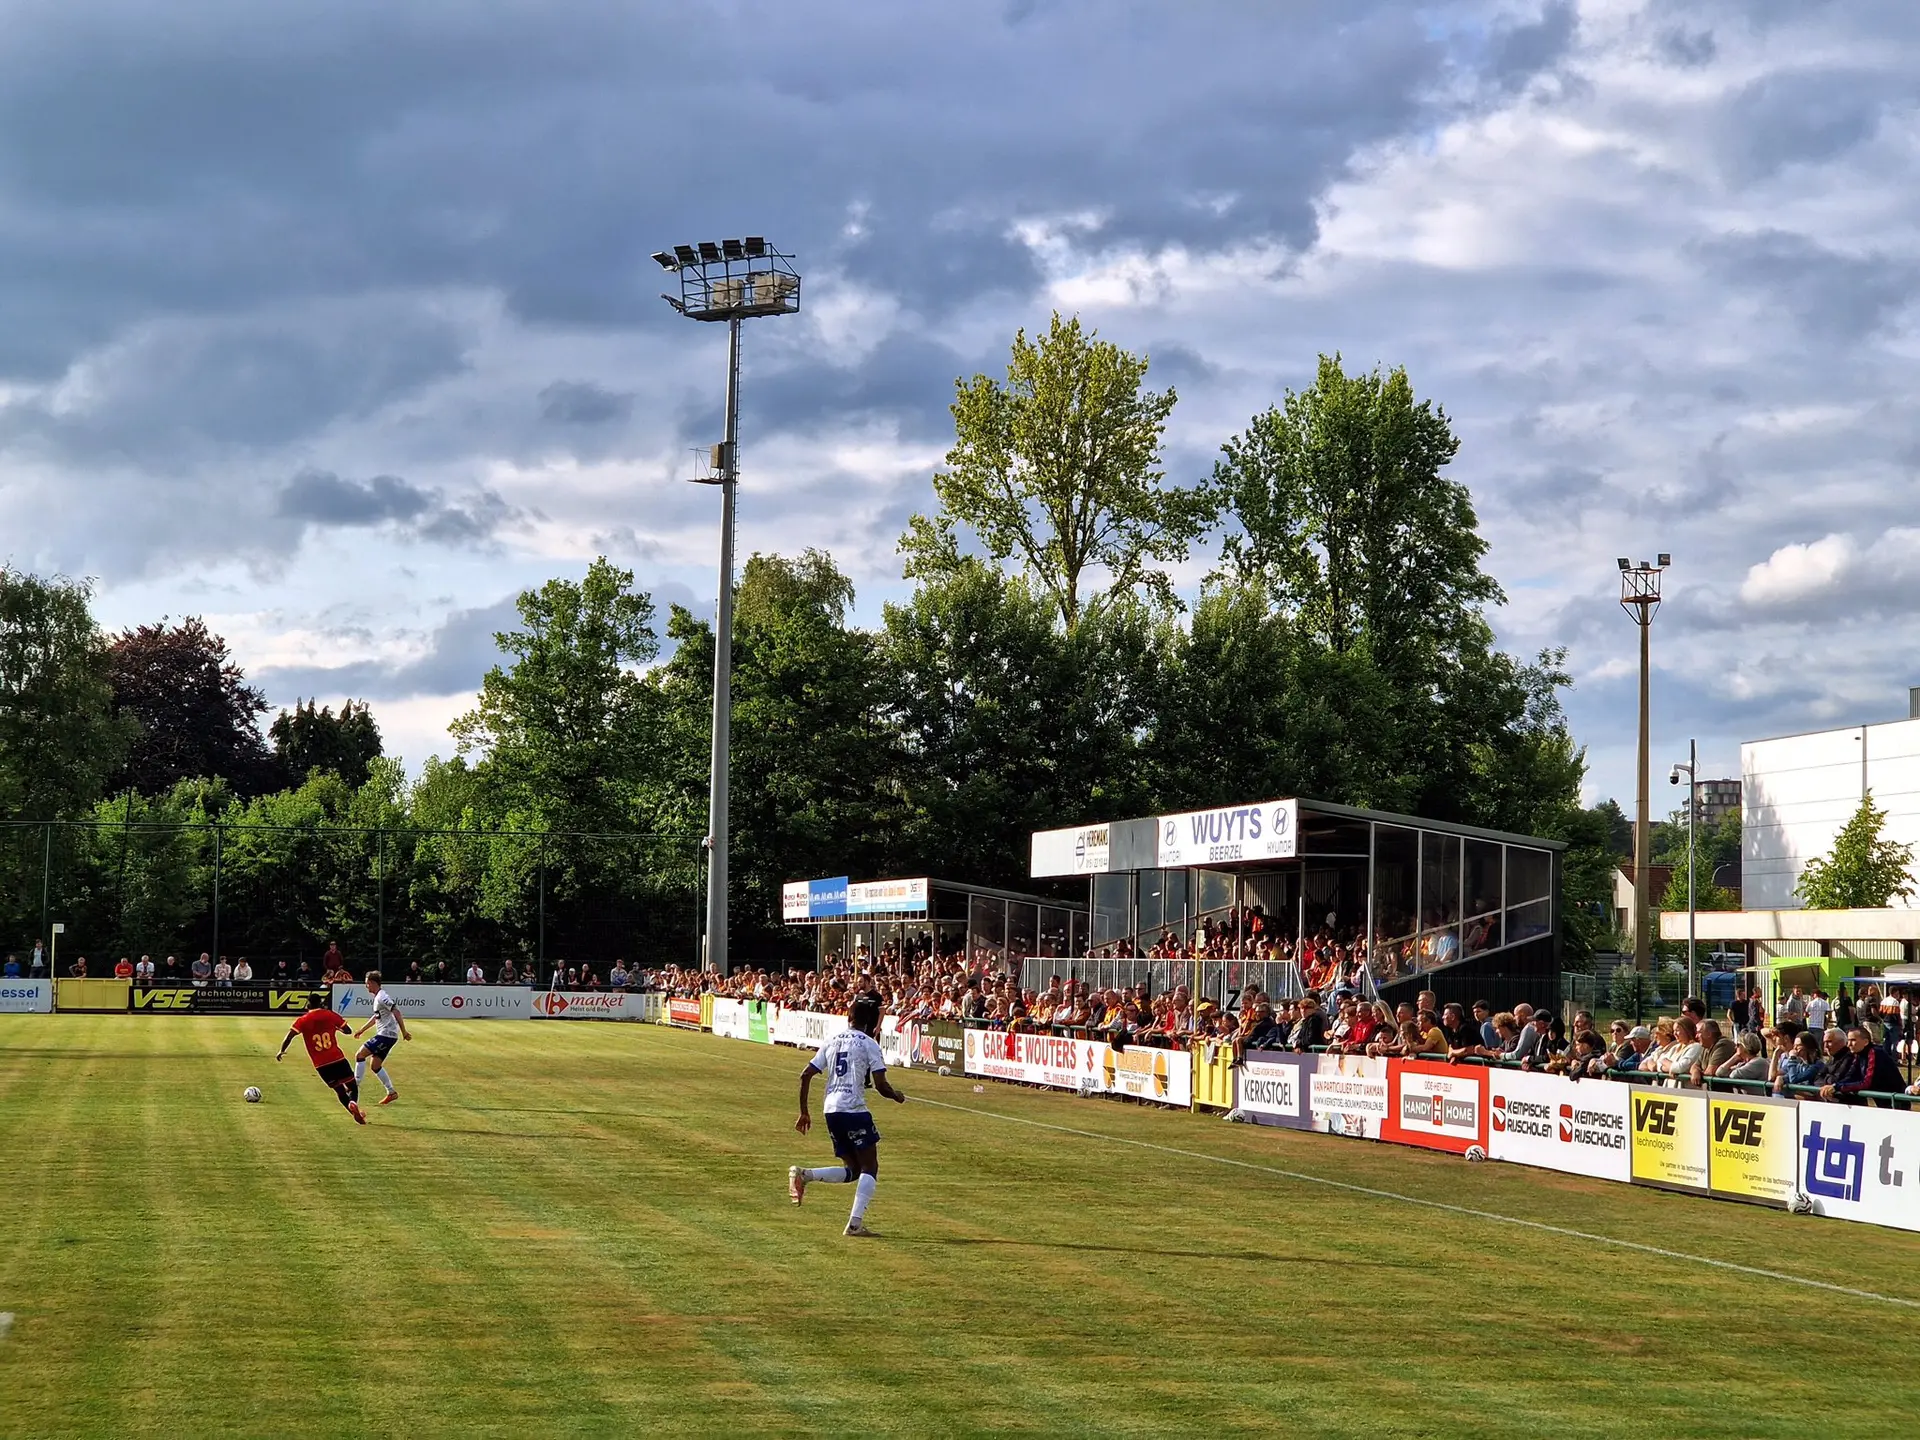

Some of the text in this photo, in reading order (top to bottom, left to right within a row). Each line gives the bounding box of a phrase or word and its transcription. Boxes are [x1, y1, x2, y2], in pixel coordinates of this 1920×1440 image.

[1191, 808, 1262, 844] WUYTS
[1209, 844, 1243, 861] BEERZEL
[1266, 840, 1294, 854] HYUNDAI
[0, 987, 39, 999] essel
[133, 988, 196, 1009] VSE
[197, 989, 264, 1000] technologies
[391, 996, 426, 1007] olutions
[570, 993, 626, 1008] market
[312, 1031, 332, 1052] 38
[983, 1033, 1077, 1070] GARE WOUTERS
[836, 1051, 849, 1078] 5
[1081, 1077, 1099, 1089] SUZUKI
[1244, 1079, 1293, 1106] KERKSTOEL
[1323, 1081, 1353, 1095] PARTICULIER
[1353, 1083, 1363, 1095] TOT
[1363, 1084, 1384, 1097] VAKMAN
[1405, 1100, 1473, 1122] HANDY HOME
[1507, 1100, 1550, 1120] KEMPISCHE
[1574, 1109, 1623, 1131] KEMPISCHE
[1635, 1098, 1679, 1136] VSE
[1713, 1107, 1766, 1147] VSE
[1636, 1136, 1674, 1152] technologies
[1715, 1147, 1760, 1164] technologies
